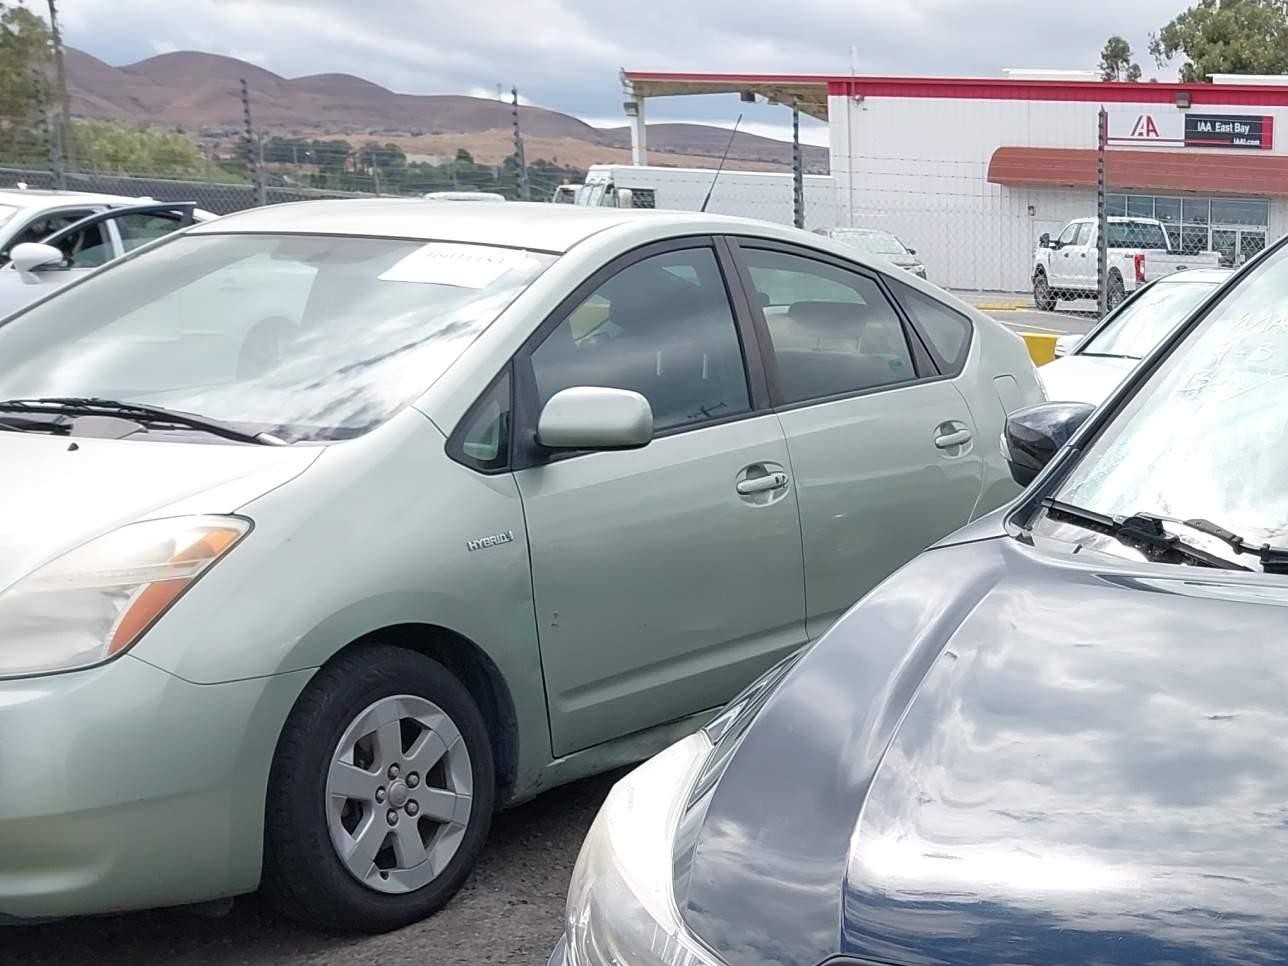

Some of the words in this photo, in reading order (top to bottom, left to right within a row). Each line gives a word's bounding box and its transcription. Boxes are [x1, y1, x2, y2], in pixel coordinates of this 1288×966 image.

[1197, 121, 1212, 132] IAA
[1215, 122, 1233, 132] East
[1234, 123, 1250, 135] Bay
[467, 532, 510, 551] HYBRID
